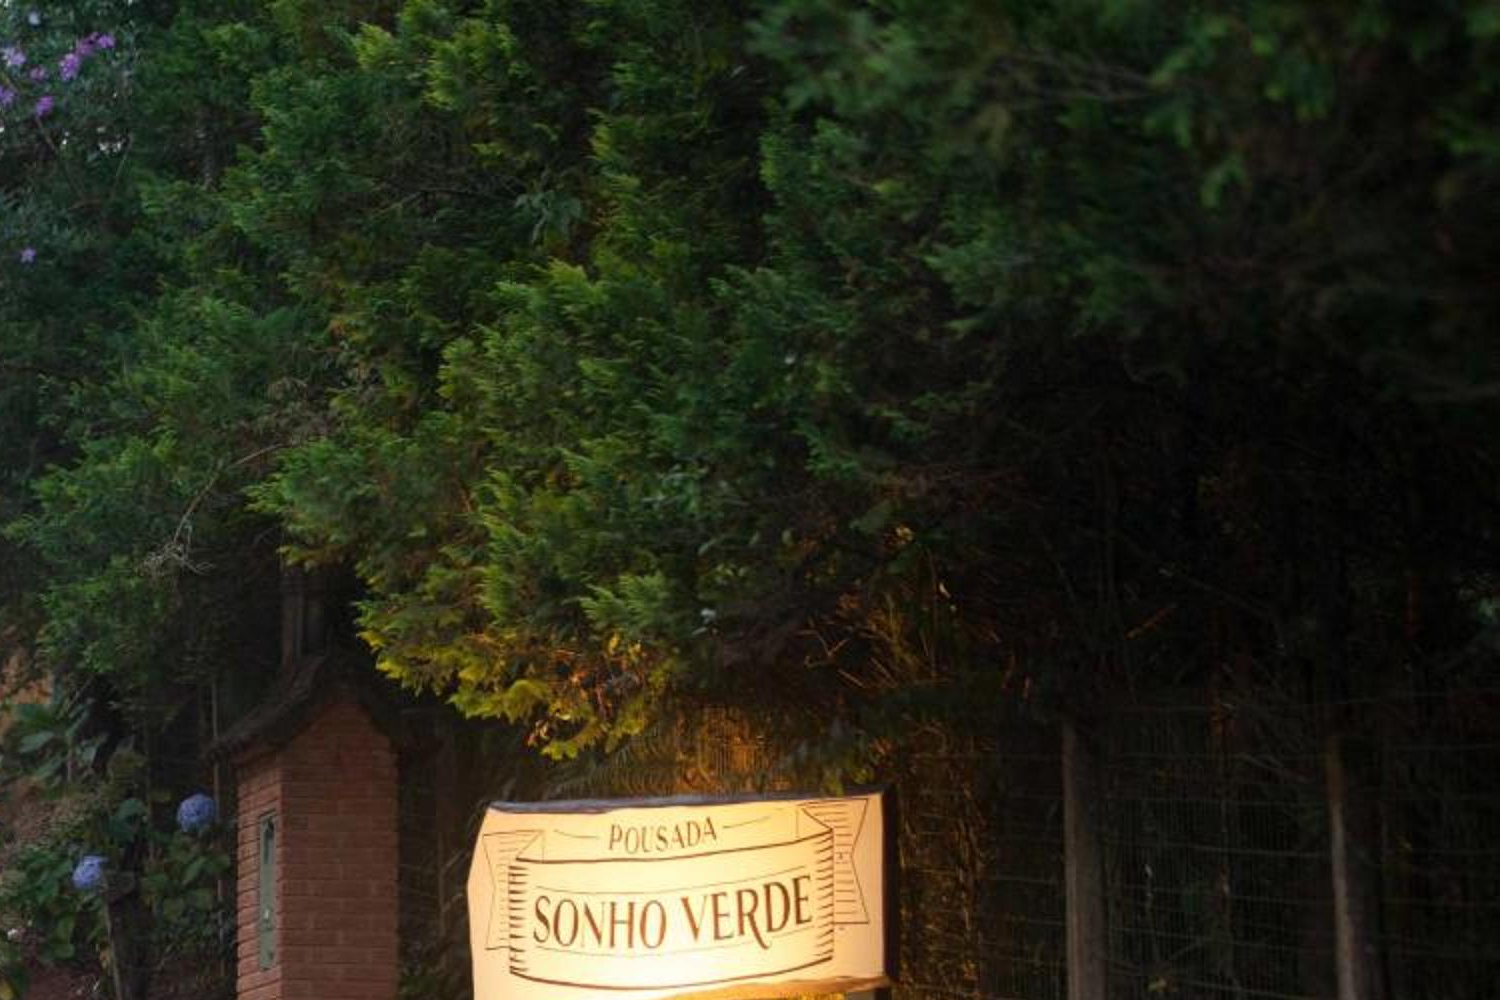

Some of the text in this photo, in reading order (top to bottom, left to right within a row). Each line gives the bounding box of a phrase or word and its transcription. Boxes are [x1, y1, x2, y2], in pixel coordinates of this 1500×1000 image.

[608, 816, 718, 853] POUSADA
[533, 875, 812, 949] SONHO VERDE
